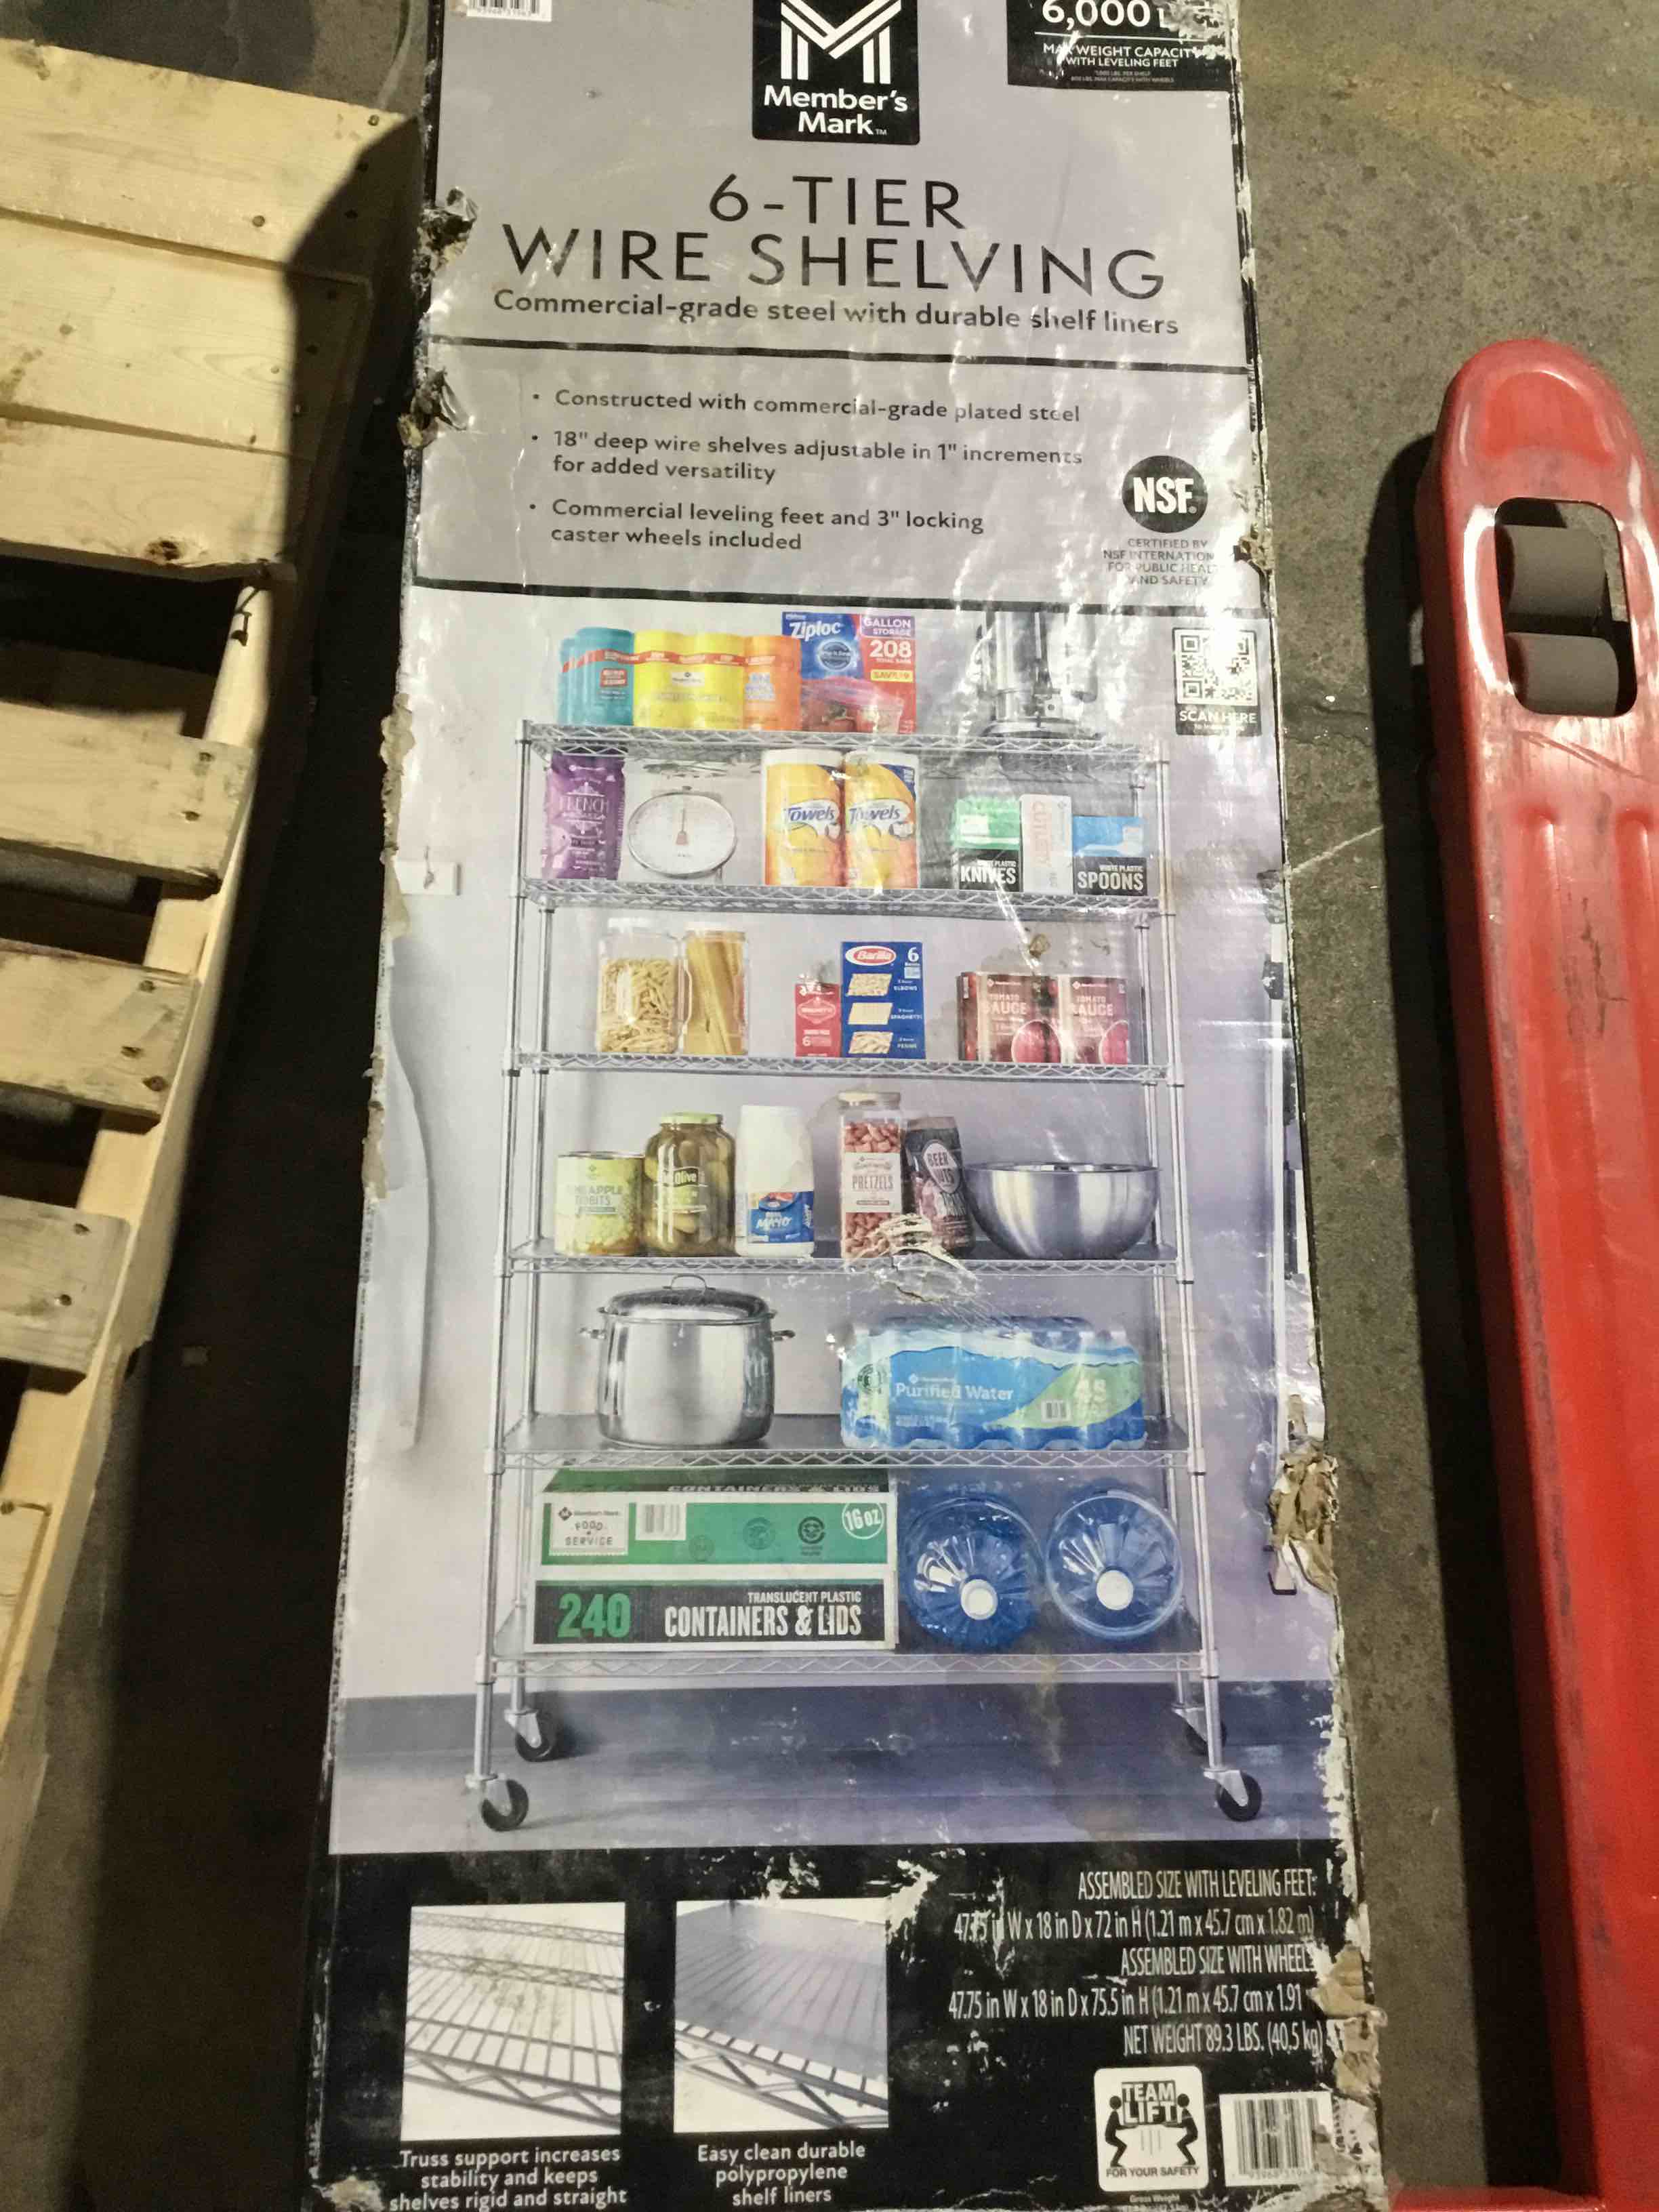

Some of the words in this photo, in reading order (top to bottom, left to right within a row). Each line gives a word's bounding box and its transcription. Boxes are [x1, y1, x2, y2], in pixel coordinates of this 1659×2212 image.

[1042, 0, 1151, 30] 6,000
[1066, 57, 1096, 66] WITH
[1098, 58, 1150, 68] LEVELING
[1153, 59, 1178, 68] FEET
[1076, 46, 1131, 57] WEIGHT
[1134, 47, 1197, 58] CAPACIT
[764, 85, 908, 112] Member's
[798, 112, 874, 136] Mark
[710, 173, 965, 229] 6-TIER
[503, 223, 710, 281] WIRE
[748, 233, 1165, 300] SHELVING
[493, 289, 758, 323] Commercial-grade
[767, 299, 836, 321] steel
[844, 302, 906, 323] with
[916, 303, 1020, 328] durable
[1031, 307, 1096, 331] shelf
[1104, 310, 1179, 334] liners
[556, 389, 692, 409] Constructed
[699, 393, 746, 410] with
[754, 398, 947, 421] commercial-grade
[955, 403, 1022, 423] plated
[1029, 405, 1080, 422] steel
[554, 430, 589, 447] 18"
[594, 432, 649, 454] deep
[655, 436, 701, 452] wire
[708, 436, 787, 455] shelves
[794, 440, 905, 460] adjustable
[913, 443, 931, 459] in
[937, 443, 957, 460] 1"
[963, 445, 1083, 465] increments
[554, 455, 586, 472] for
[591, 457, 658, 476] added
[665, 463, 776, 485] versatility
[1133, 476, 1194, 514] NSF
[552, 499, 682, 520] Commercial
[691, 503, 773, 528] leveling
[781, 507, 824, 525] feet
[831, 510, 869, 527] and
[878, 510, 899, 527] 3"
[907, 511, 983, 534] locking
[551, 529, 620, 543] caster
[626, 527, 701, 547] wheels
[709, 531, 802, 550] included
[1128, 538, 1189, 548] CERTIFIED
[1192, 539, 1208, 549] BY
[1103, 550, 1125, 560] NSF
[1129, 550, 1215, 561] INTERNATION
[1108, 562, 1132, 572] FOR
[1135, 562, 1178, 573] PUBLIC
[1181, 564, 1218, 575] HEAL
[1128, 575, 1158, 585] AND
[1162, 575, 1208, 586] SAFETY
[789, 621, 842, 642] Ziploc
[863, 617, 912, 628] GALLON
[869, 639, 912, 658] 208
[1180, 710, 1219, 722] SCAN
[784, 805, 836, 821] Towels
[848, 804, 901, 824] Towels
[960, 865, 1017, 884] KNIVES
[1077, 871, 1144, 890] SPOONS
[907, 947, 920, 962] 6
[927, 1152, 949, 1166] BEER
[852, 1175, 894, 1189] PRETZELS
[895, 1382, 962, 1399] Purified
[965, 1385, 1015, 1400] Water
[575, 1520, 603, 1530] FOOD
[846, 1509, 863, 1531] 16
[565, 1536, 613, 1546] SERVICE
[747, 1591, 819, 1603] TRANSLUCENT
[821, 1591, 862, 1603] PLASTIC
[557, 1593, 631, 1639] 240
[664, 1605, 789, 1637] CONTAINERS
[794, 1605, 813, 1636] &
[818, 1604, 862, 1636] LIDS
[1078, 1870, 1152, 1900] ASSEMBLED
[1156, 1870, 1182, 1898] SIZE
[1184, 1870, 1219, 1898] WITH
[1222, 1869, 1281, 1897] LEVELING
[1008, 1909, 1021, 1940] W
[1025, 1918, 1033, 1940] x
[1036, 1911, 1052, 1939] 18
[1055, 1911, 1069, 1939] in
[1072, 1910, 1082, 1938] D
[1085, 1917, 1092, 1938] x
[1095, 1910, 1112, 1938] 72
[1115, 1910, 1128, 1938] in
[1132, 1908, 1141, 1938] H
[1145, 1908, 1174, 1941] (1.21
[1179, 1914, 1192, 1936] m
[1195, 1914, 1203, 1936] x
[1205, 1908, 1231, 1936] 45.7
[1235, 1914, 1254, 1936] cm
[1256, 1914, 1265, 1935] x
[1268, 1906, 1294, 1934] 1.82
[1296, 1905, 1314, 1936] m)
[1121, 1946, 1196, 1975] ASSEMBLED
[1199, 1946, 1225, 1975] SIZE
[1227, 1944, 1262, 1973] WITH
[1265, 1944, 1317, 1973] WHEEL
[949, 1991, 982, 2020] 47.75
[986, 1992, 1000, 2018] in
[1003, 1989, 1017, 2018] W
[1021, 1996, 1029, 2018] x
[1032, 1989, 1048, 2017] 18
[1050, 1989, 1064, 2017] in
[1068, 1988, 1078, 2016] D
[1080, 1995, 1088, 2016] x
[1091, 1988, 1118, 2016] 75.5
[1122, 1988, 1134, 2015] in
[1139, 1986, 1149, 2015] H
[1152, 1985, 1182, 2019] (1.21
[1187, 1992, 1200, 2014] m
[1202, 1992, 1211, 2013] x
[1213, 1984, 1239, 2013] 45.7
[1244, 1990, 1263, 2012] cm
[1266, 1990, 1274, 2011] x
[1277, 1983, 1303, 2011] 1.91
[1123, 2026, 1148, 2056] NET
[1151, 2023, 1203, 2055] WEIGHT
[1206, 2024, 1233, 2052] 89.3
[1236, 2022, 1265, 2051] LBS.
[1267, 2020, 1300, 2056] (40.5
[1303, 2020, 1323, 2057] kg)
[1122, 2081, 1175, 2101] TEAM
[1124, 2102, 1179, 2124] LIFT
[400, 2150, 450, 2168] Truss
[455, 2148, 529, 2169] support
[535, 2146, 621, 2164] increases
[697, 2144, 739, 2167] Easy
[744, 2142, 792, 2160] clean
[797, 2140, 866, 2159] durable
[421, 2170, 499, 2191] stability
[504, 2168, 538, 2186] and
[544, 2166, 598, 2188] keeps
[716, 2163, 848, 2188] polypropylene
[1106, 2167, 1127, 2178] FOR
[1129, 2167, 1158, 2177] YOUR
[1160, 2166, 1200, 2177] SAFETY
[390, 2191, 460, 2212] shelves
[466, 2189, 508, 2212] rigid
[513, 2188, 548, 2207] and
[553, 2186, 628, 2210] straight
[733, 2186, 779, 2207] shelf
[783, 2186, 832, 2205] liners
